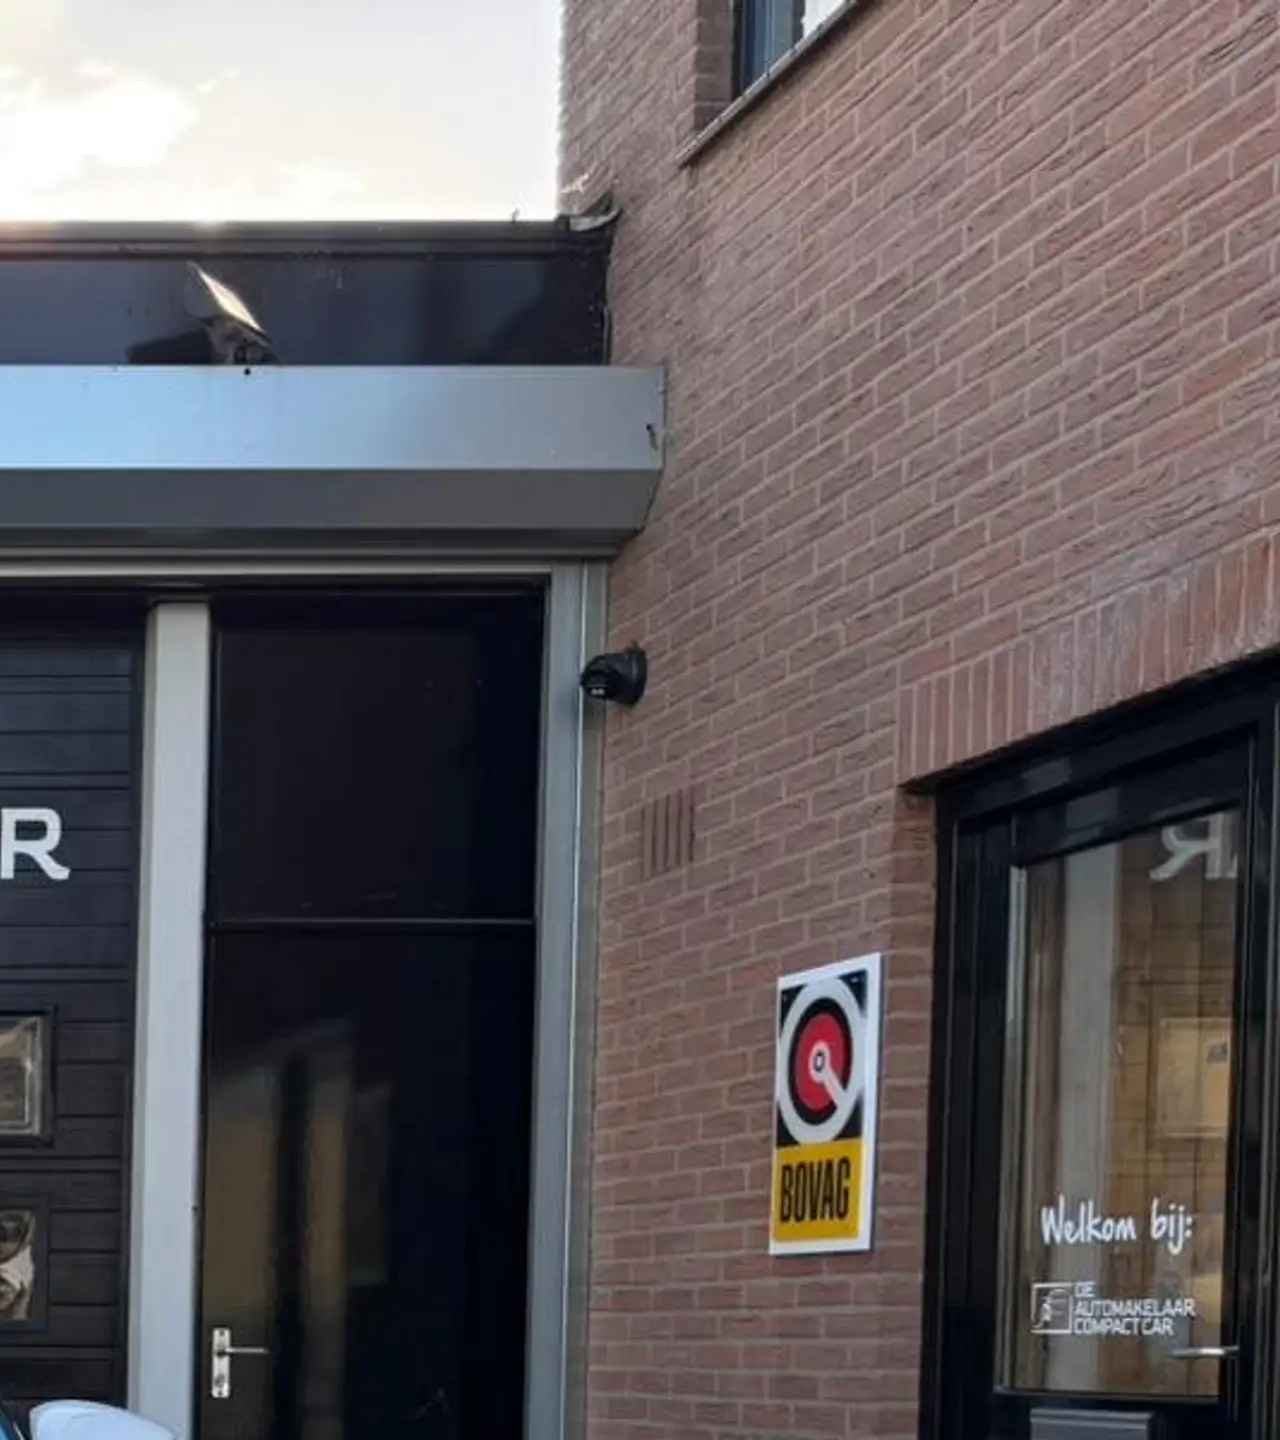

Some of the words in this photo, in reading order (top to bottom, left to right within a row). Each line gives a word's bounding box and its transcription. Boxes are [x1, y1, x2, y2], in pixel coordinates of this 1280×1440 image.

[779, 1156, 850, 1222] BOVAG
[1042, 1194, 1136, 1244] Welkom
[1151, 1197, 1192, 1255] bij:
[1074, 1282, 1095, 1297] DE
[1074, 1298, 1197, 1317] AUTOMAKELAAR
[1073, 1317, 1140, 1336] COMPACT
[1141, 1317, 1175, 1337] CAR
